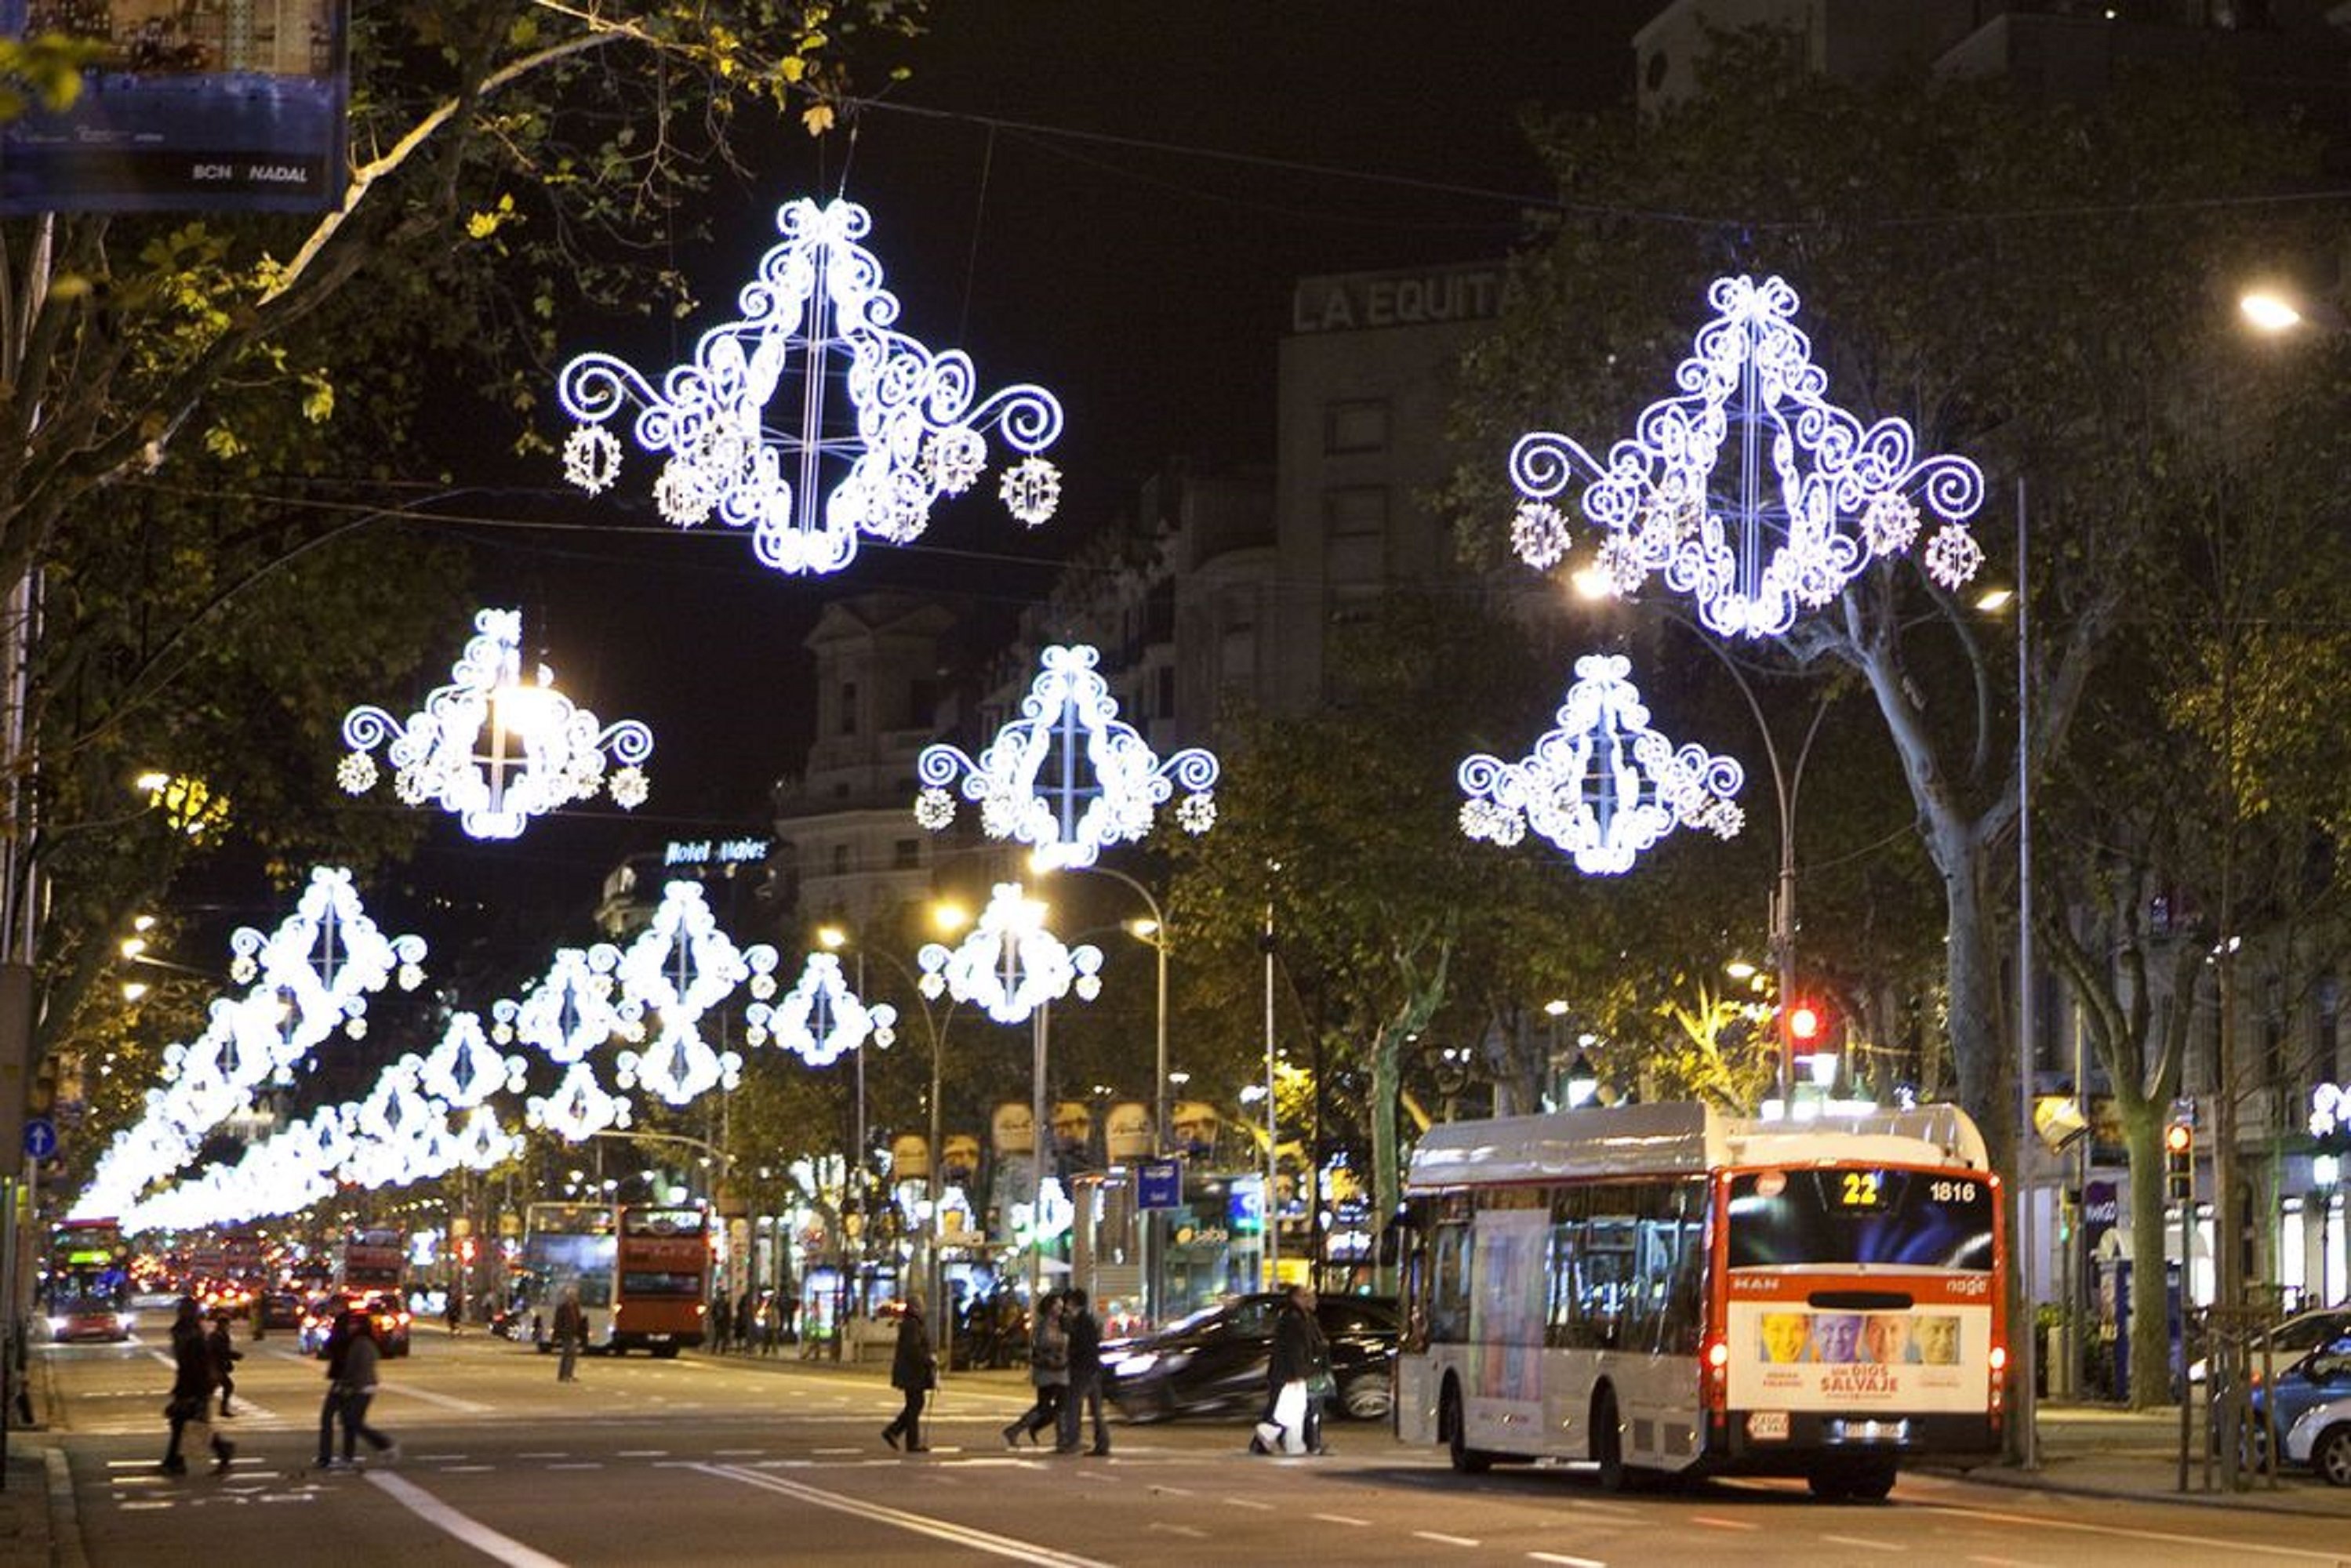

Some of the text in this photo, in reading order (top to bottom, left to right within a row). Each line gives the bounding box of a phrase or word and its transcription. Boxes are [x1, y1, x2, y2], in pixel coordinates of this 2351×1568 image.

[192, 164, 308, 183] BCN NADAL
[1293, 271, 1506, 332] LA EQUIT
[665, 840, 712, 866] Hotel
[1842, 1173, 1878, 1205] 22
[1929, 1181, 1976, 1203] 1816
[1732, 1277, 1780, 1290] MAN
[1851, 1365, 1889, 1377] DIOS
[1820, 1376, 1899, 1392] SALVAJE
